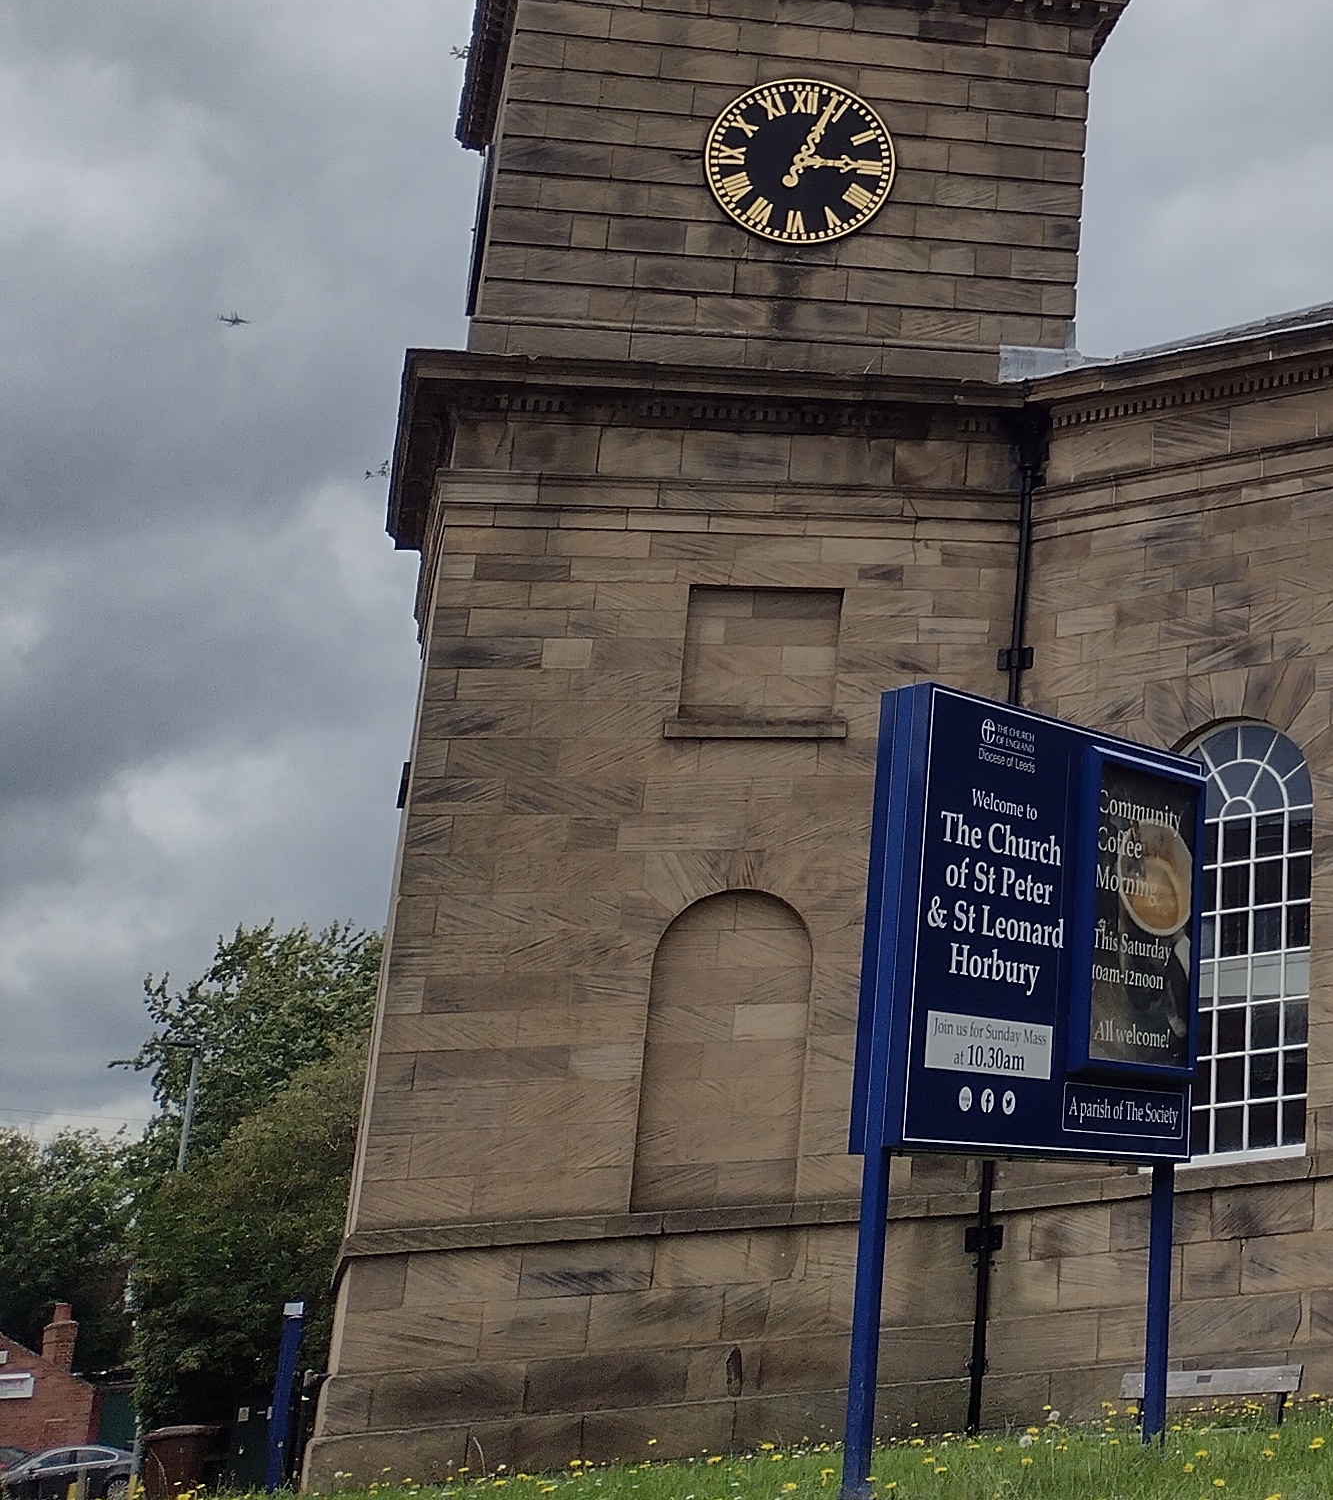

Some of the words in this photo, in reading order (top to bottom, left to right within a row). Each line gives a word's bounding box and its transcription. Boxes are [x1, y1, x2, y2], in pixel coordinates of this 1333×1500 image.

[979, 748, 1005, 765] Diocese
[1006, 756, 1014, 767] of
[1015, 758, 1035, 773] Leeds
[972, 788, 1023, 817] Welcome
[1026, 804, 1037, 820] to
[1100, 789, 1181, 838] Community
[941, 811, 982, 849] The
[988, 823, 1061, 866] Church
[1098, 826, 1142, 859] Coffee
[946, 857, 969, 888] of
[974, 862, 996, 894] St
[1000, 866, 1053, 905] Peter
[1096, 863, 1157, 907] Morning
[927, 895, 947, 929] &
[953, 900, 976, 933] St
[981, 905, 1064, 948] Leonard
[1094, 928, 1118, 952] This
[1120, 933, 1172, 966] Saturday
[949, 942, 1040, 996] Horbury
[933, 1017, 953, 1036] Join
[956, 1025, 967, 1036] us
[970, 1022, 984, 1038] for
[986, 1024, 1021, 1048] Sunday
[1023, 1028, 1047, 1046] Mass
[1094, 1018, 1116, 1042] All
[1115, 1023, 1171, 1049] welcome!
[953, 1051, 964, 1065] at
[967, 1044, 1025, 1071] 10.30am
[1068, 1095, 1078, 1116] A
[1079, 1098, 1111, 1124] parish
[1113, 1100, 1124, 1120] of
[1125, 1101, 1144, 1122] The
[1145, 1102, 1179, 1130] Society
